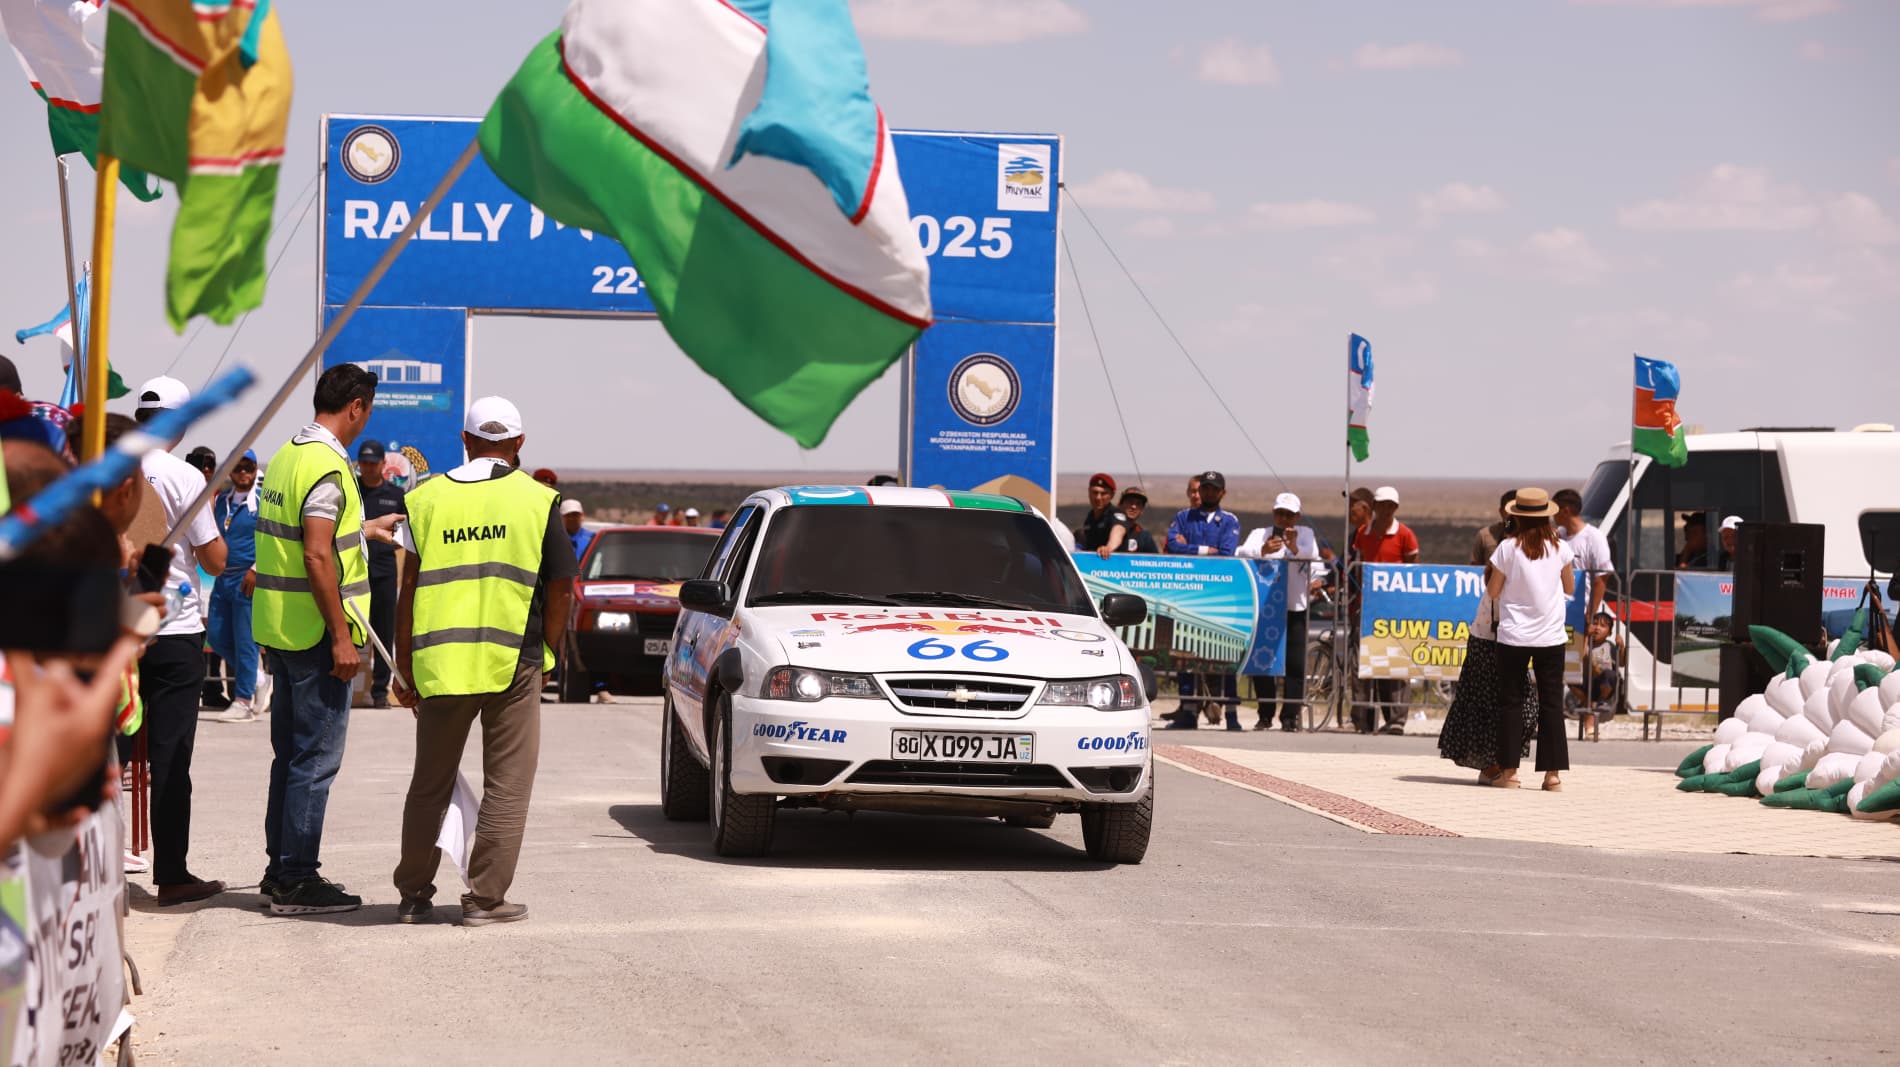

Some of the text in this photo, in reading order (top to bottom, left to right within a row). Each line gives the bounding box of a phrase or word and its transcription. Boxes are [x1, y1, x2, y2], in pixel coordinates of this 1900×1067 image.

[344, 200, 512, 242] RALLY
[909, 214, 1013, 259] 025
[591, 265, 647, 294] 22-
[443, 524, 506, 544] HAKAM
[1119, 580, 1204, 591] VAZIRLAR KENGASHI
[1174, 573, 1234, 583] RESPUBLIKASI
[1372, 570, 1486, 598] RALLY M
[1823, 587, 1856, 599] YNAK
[810, 612, 1063, 628] Red Bull
[1373, 619, 1431, 640] SUW
[1437, 620, 1471, 641] BA
[906, 637, 1010, 662] 66
[1412, 641, 1468, 667] ÓMI
[753, 721, 848, 743] GOODYEAR
[1077, 731, 1148, 753] GOODYE
[898, 737, 919, 754] 80
